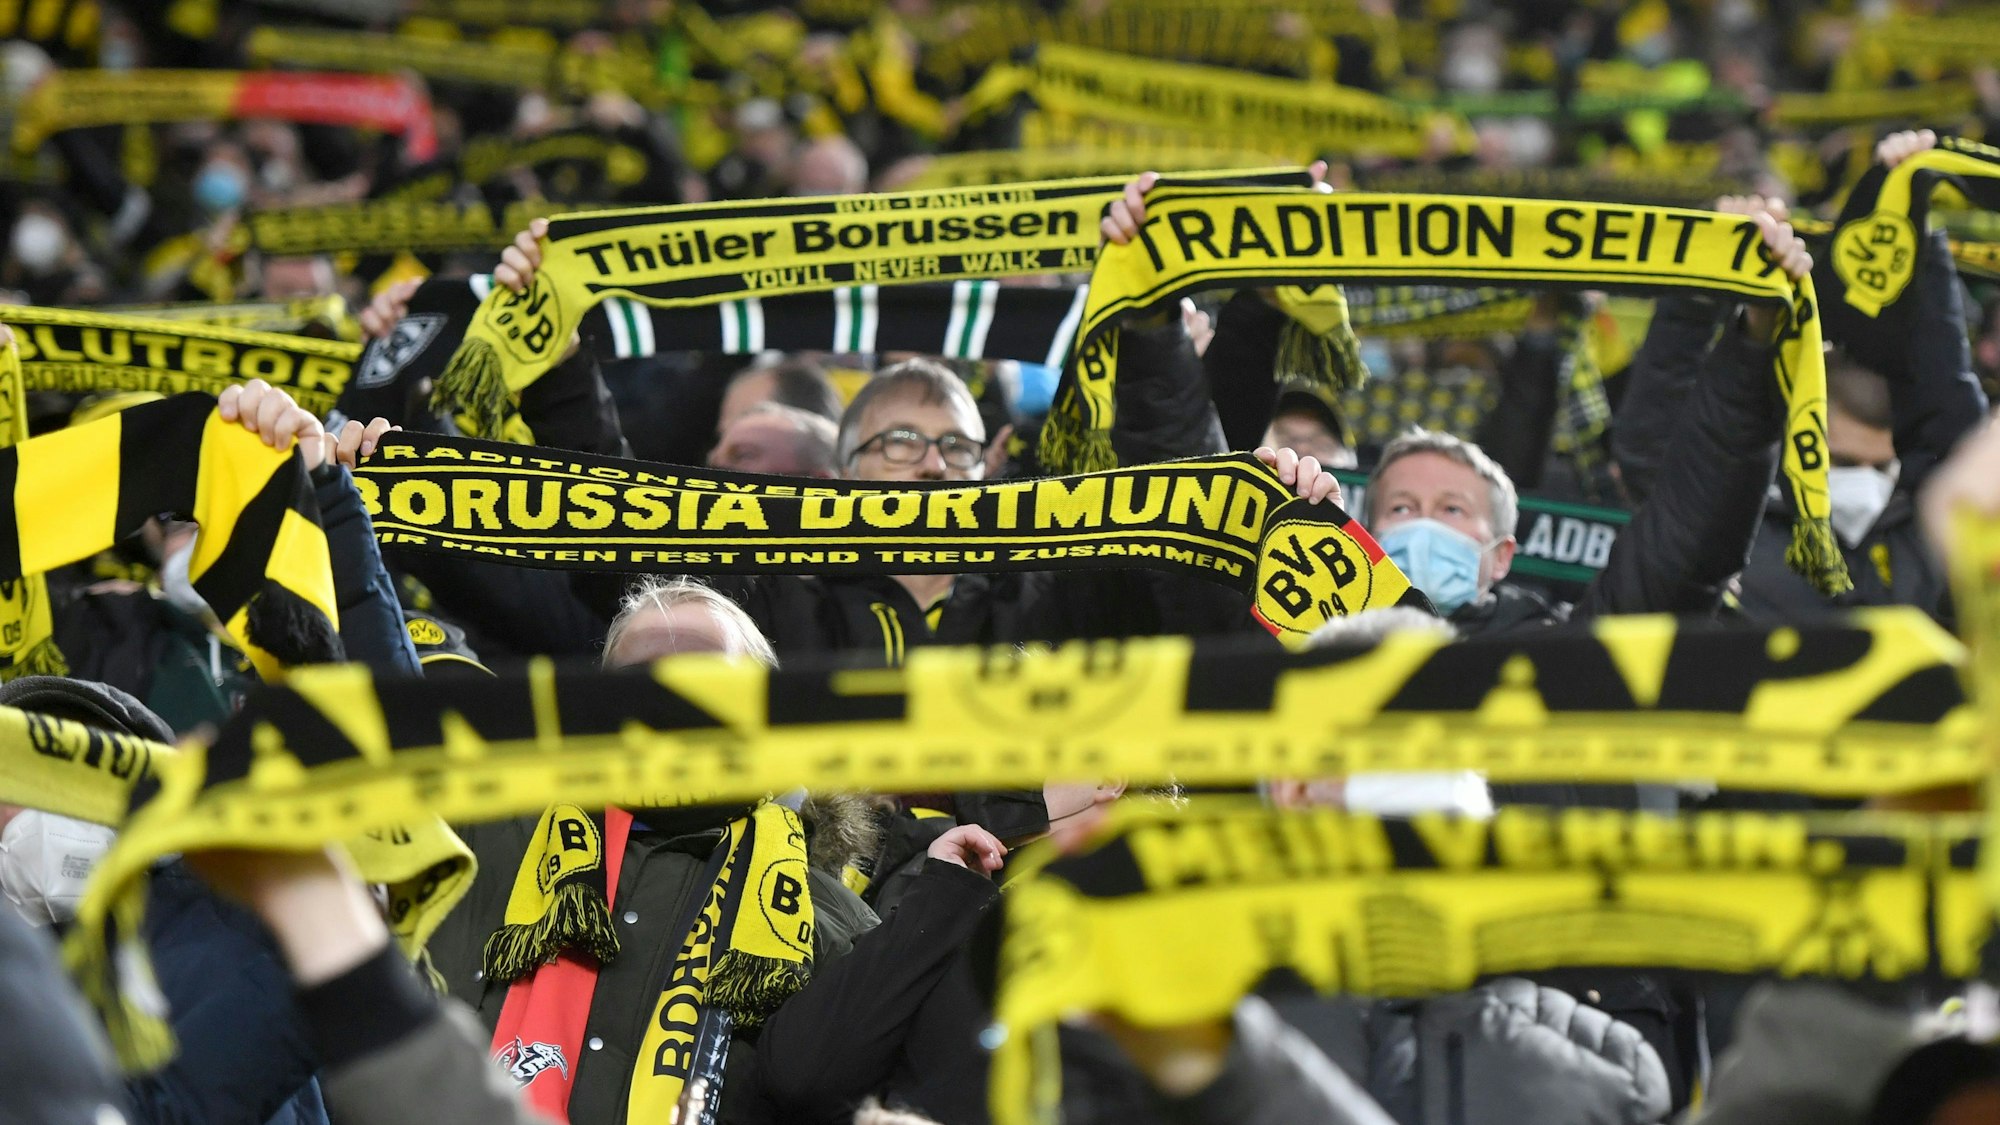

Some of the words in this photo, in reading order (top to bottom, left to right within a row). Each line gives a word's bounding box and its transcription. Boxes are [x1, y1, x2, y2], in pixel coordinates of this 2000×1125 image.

[574, 230, 776, 276] Thüler
[792, 208, 1078, 255] Borussen
[853, 256, 940, 281] NEVER
[961, 250, 1041, 273] WALK
[1138, 203, 1514, 272] TRADITION
[1543, 207, 1712, 264] SEIT
[351, 476, 769, 530] BORUSSIA
[800, 474, 1268, 544] DORTMUND
[442, 539, 616, 562] HALTEN
[630, 551, 740, 563] FEST
[755, 551, 860, 564] UND
[874, 550, 996, 563] TREU
[1009, 544, 1243, 577] ZUSAMMEN
[1516, 513, 1617, 568] ADB
[1263, 534, 1357, 619] BVB
[1318, 592, 1348, 624] 09
